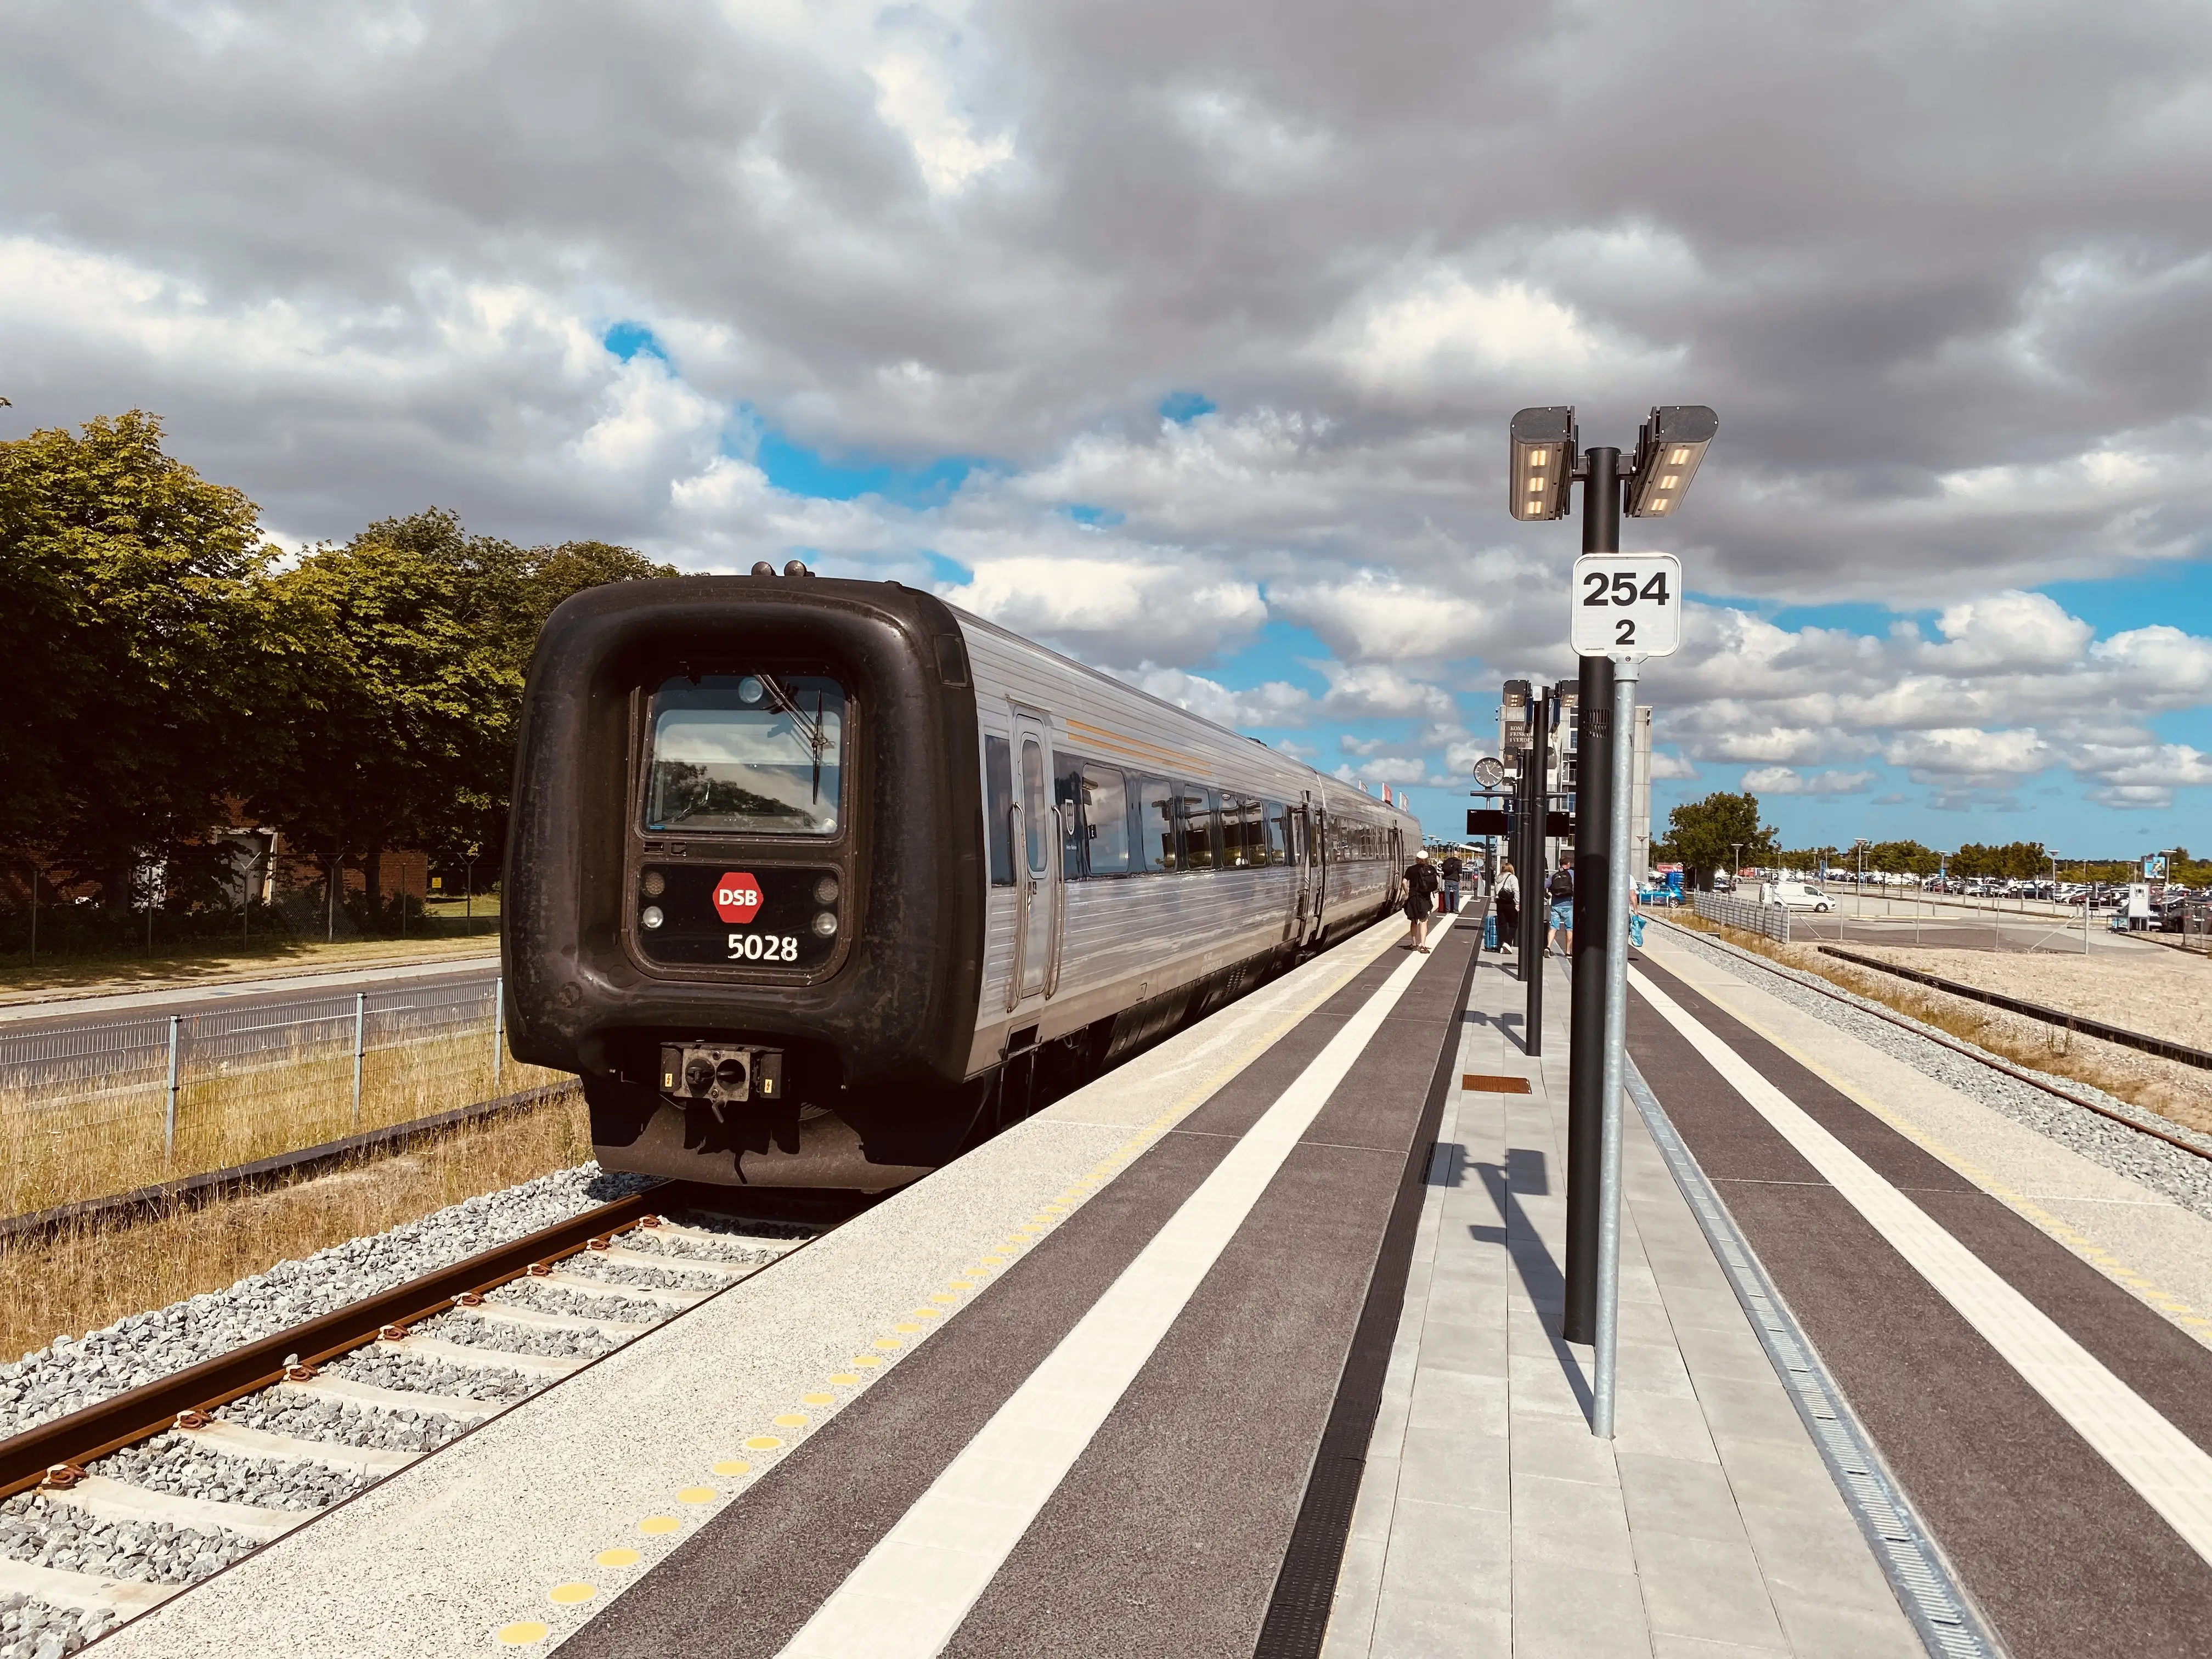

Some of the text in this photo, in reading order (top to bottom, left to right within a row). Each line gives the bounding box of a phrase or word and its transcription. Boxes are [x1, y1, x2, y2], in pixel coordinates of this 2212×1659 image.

[1583, 572, 1670, 606] 254
[1616, 619, 1635, 645] 2
[719, 889, 758, 906] DSB
[727, 934, 798, 961] 5028
